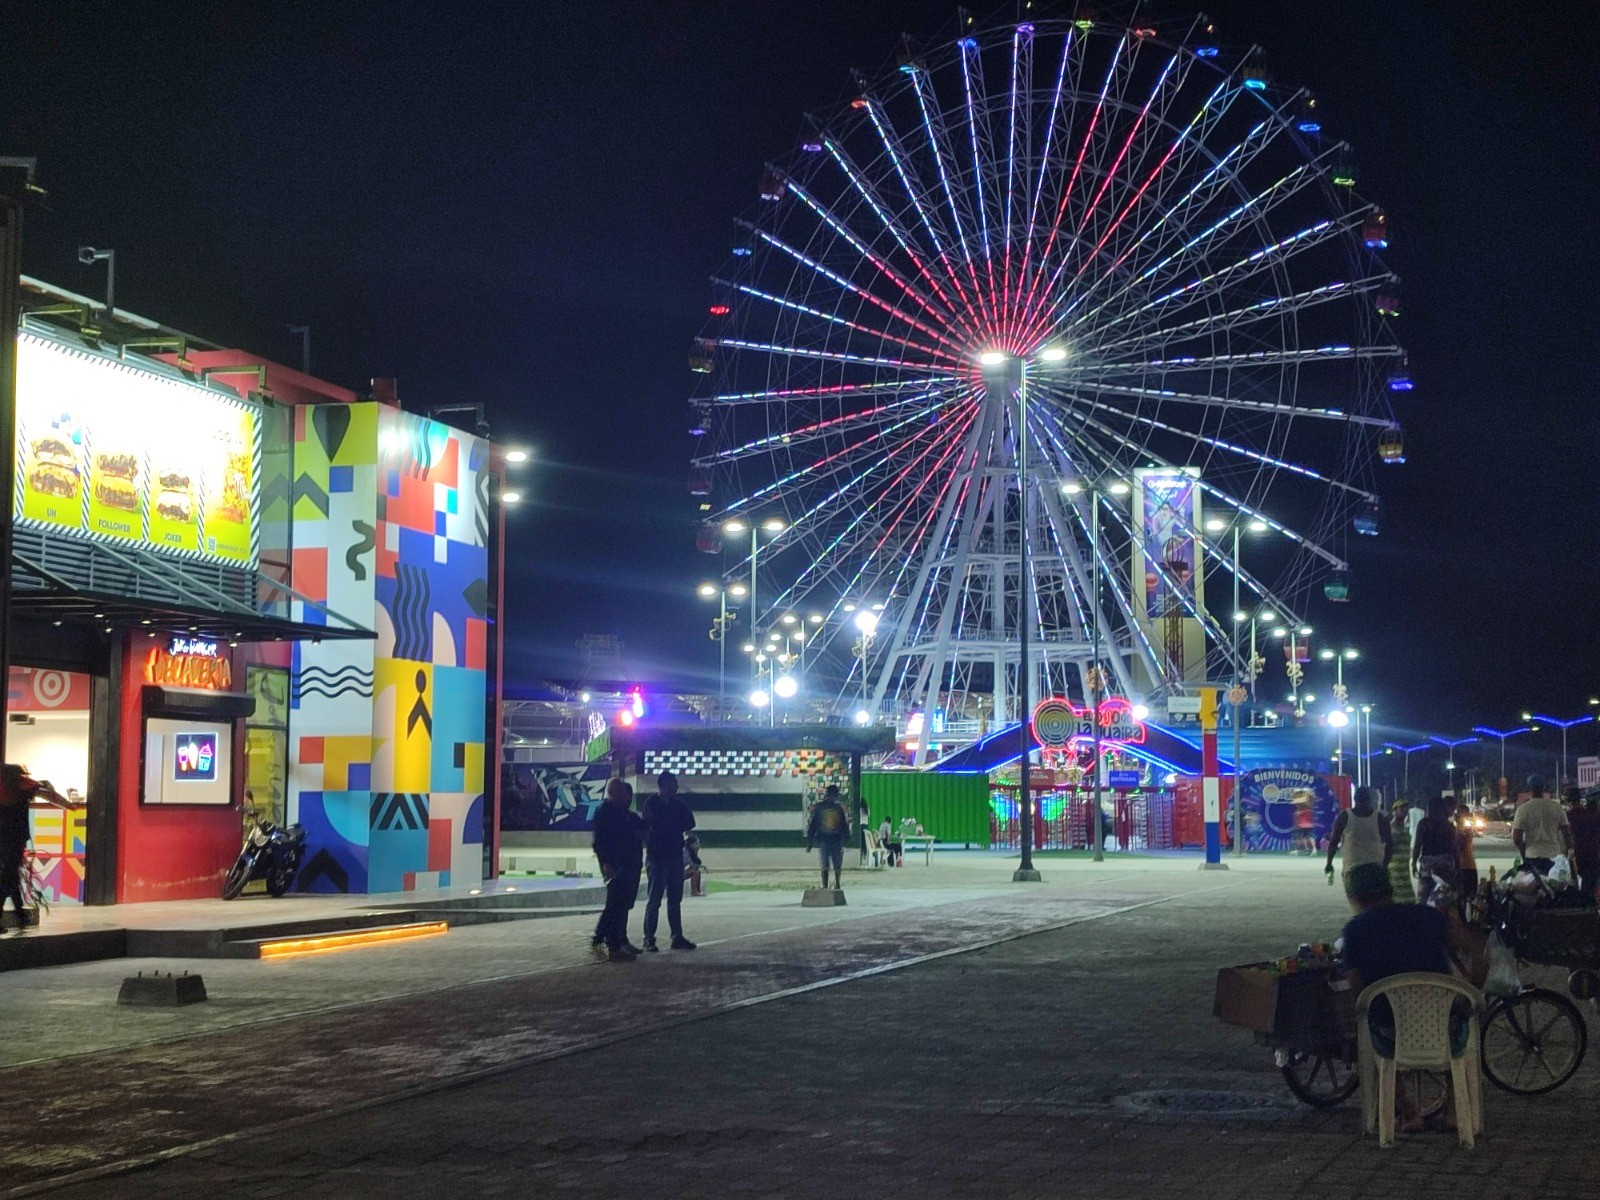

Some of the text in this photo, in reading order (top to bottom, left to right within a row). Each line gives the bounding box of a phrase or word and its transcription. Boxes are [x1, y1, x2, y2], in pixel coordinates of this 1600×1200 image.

[98, 519, 131, 533] FOLLOWER
[163, 532, 182, 543] JOKER
[1253, 770, 1315, 785] BIENVENIDOS
